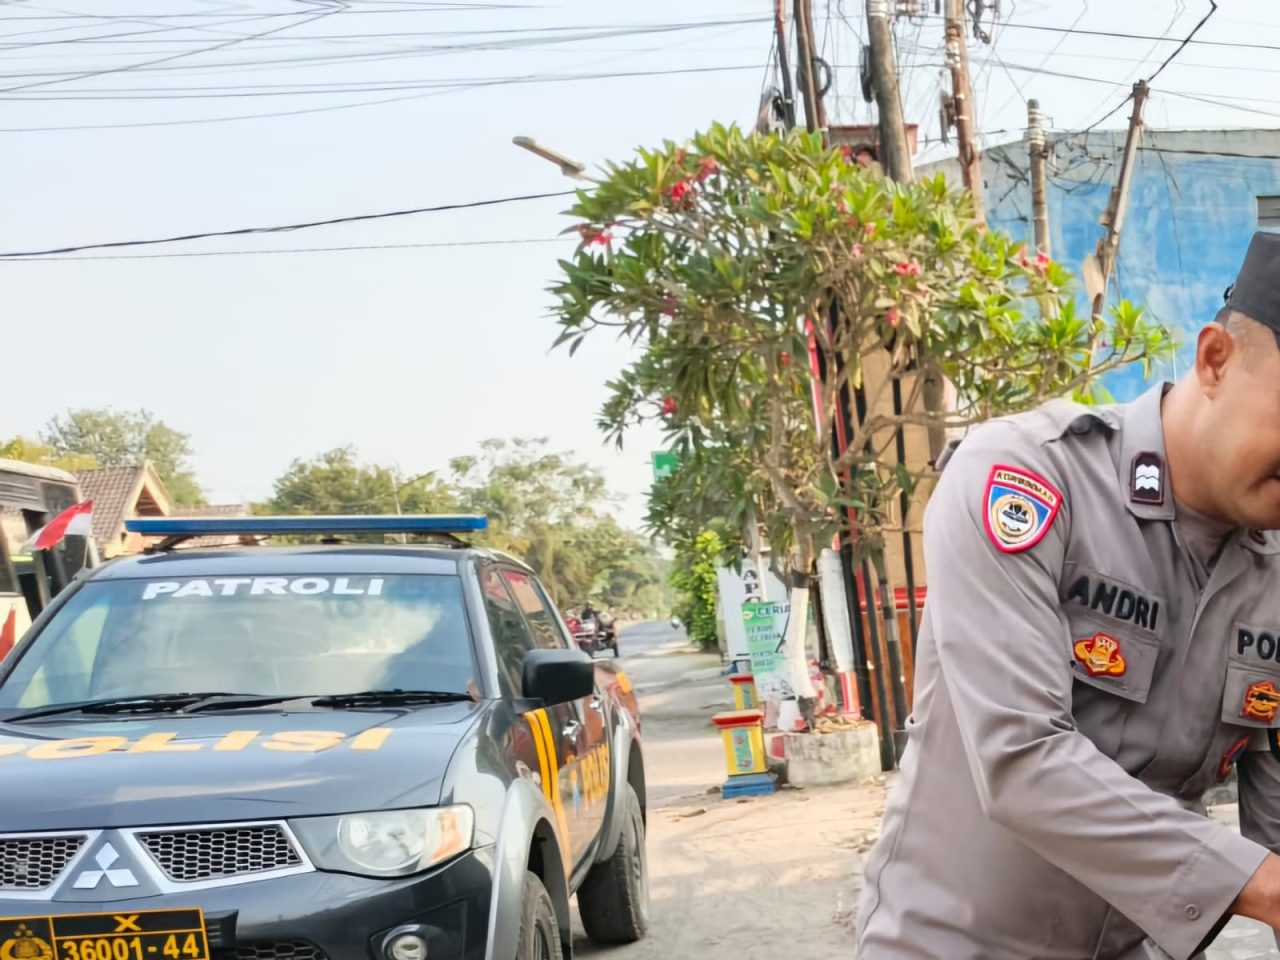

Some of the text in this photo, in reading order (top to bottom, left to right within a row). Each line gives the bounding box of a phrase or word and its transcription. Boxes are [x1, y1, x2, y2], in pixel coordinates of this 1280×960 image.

[142, 578, 384, 600] PATROLI
[1067, 576, 1159, 630] ANDRI
[114, 915, 142, 932] X
